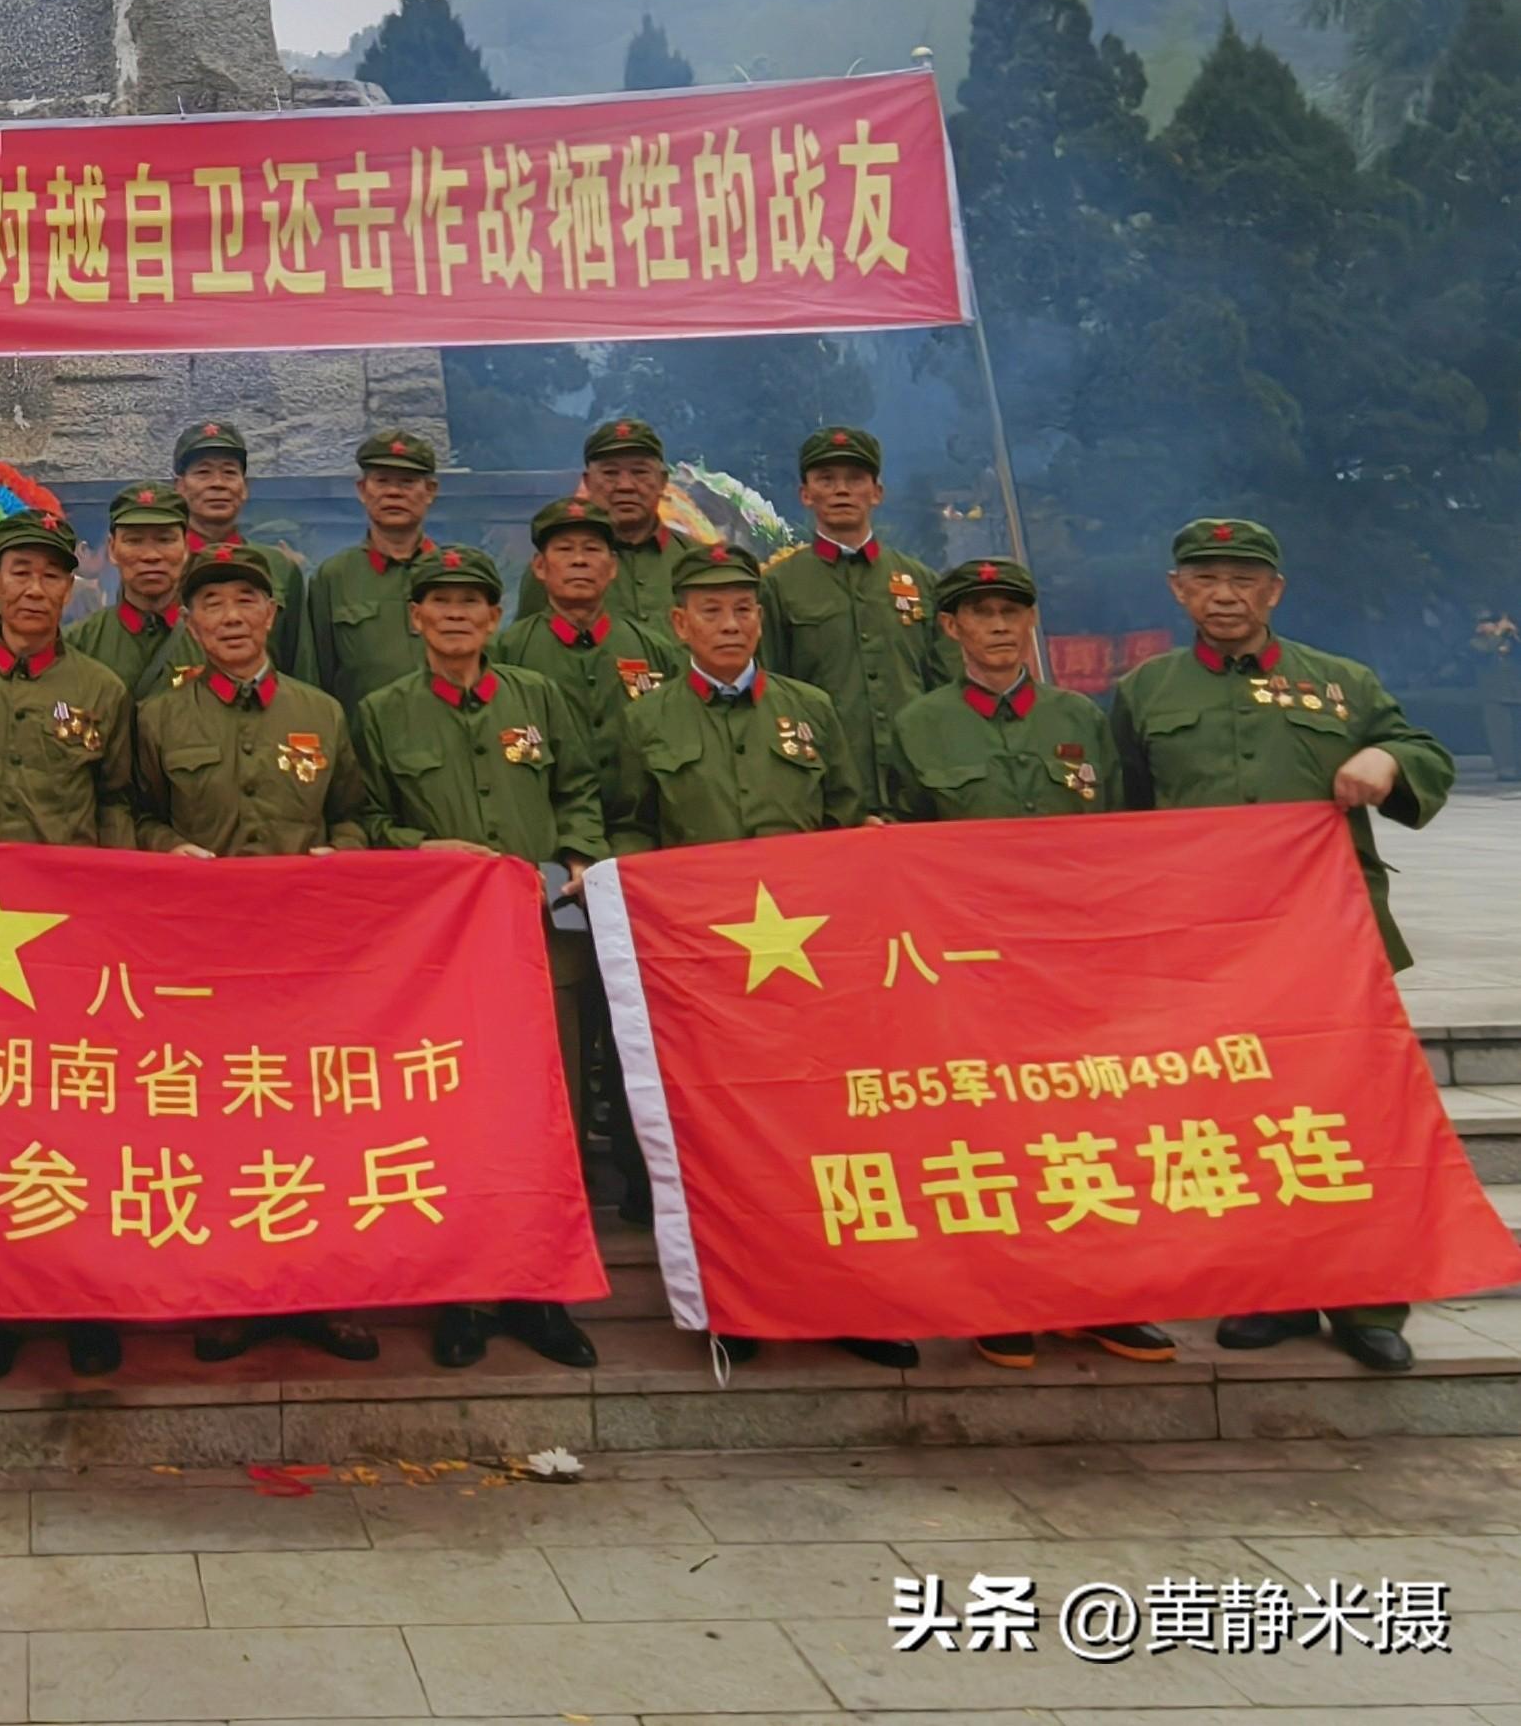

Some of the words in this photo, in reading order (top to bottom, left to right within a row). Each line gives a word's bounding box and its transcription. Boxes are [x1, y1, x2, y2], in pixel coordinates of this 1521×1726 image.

[86, 962, 213, 1019] 八一
[882, 931, 1002, 988] 八一
[845, 1033, 1274, 1119] 原55军165师494团
[810, 1105, 1374, 1247] 阻击英雄连
